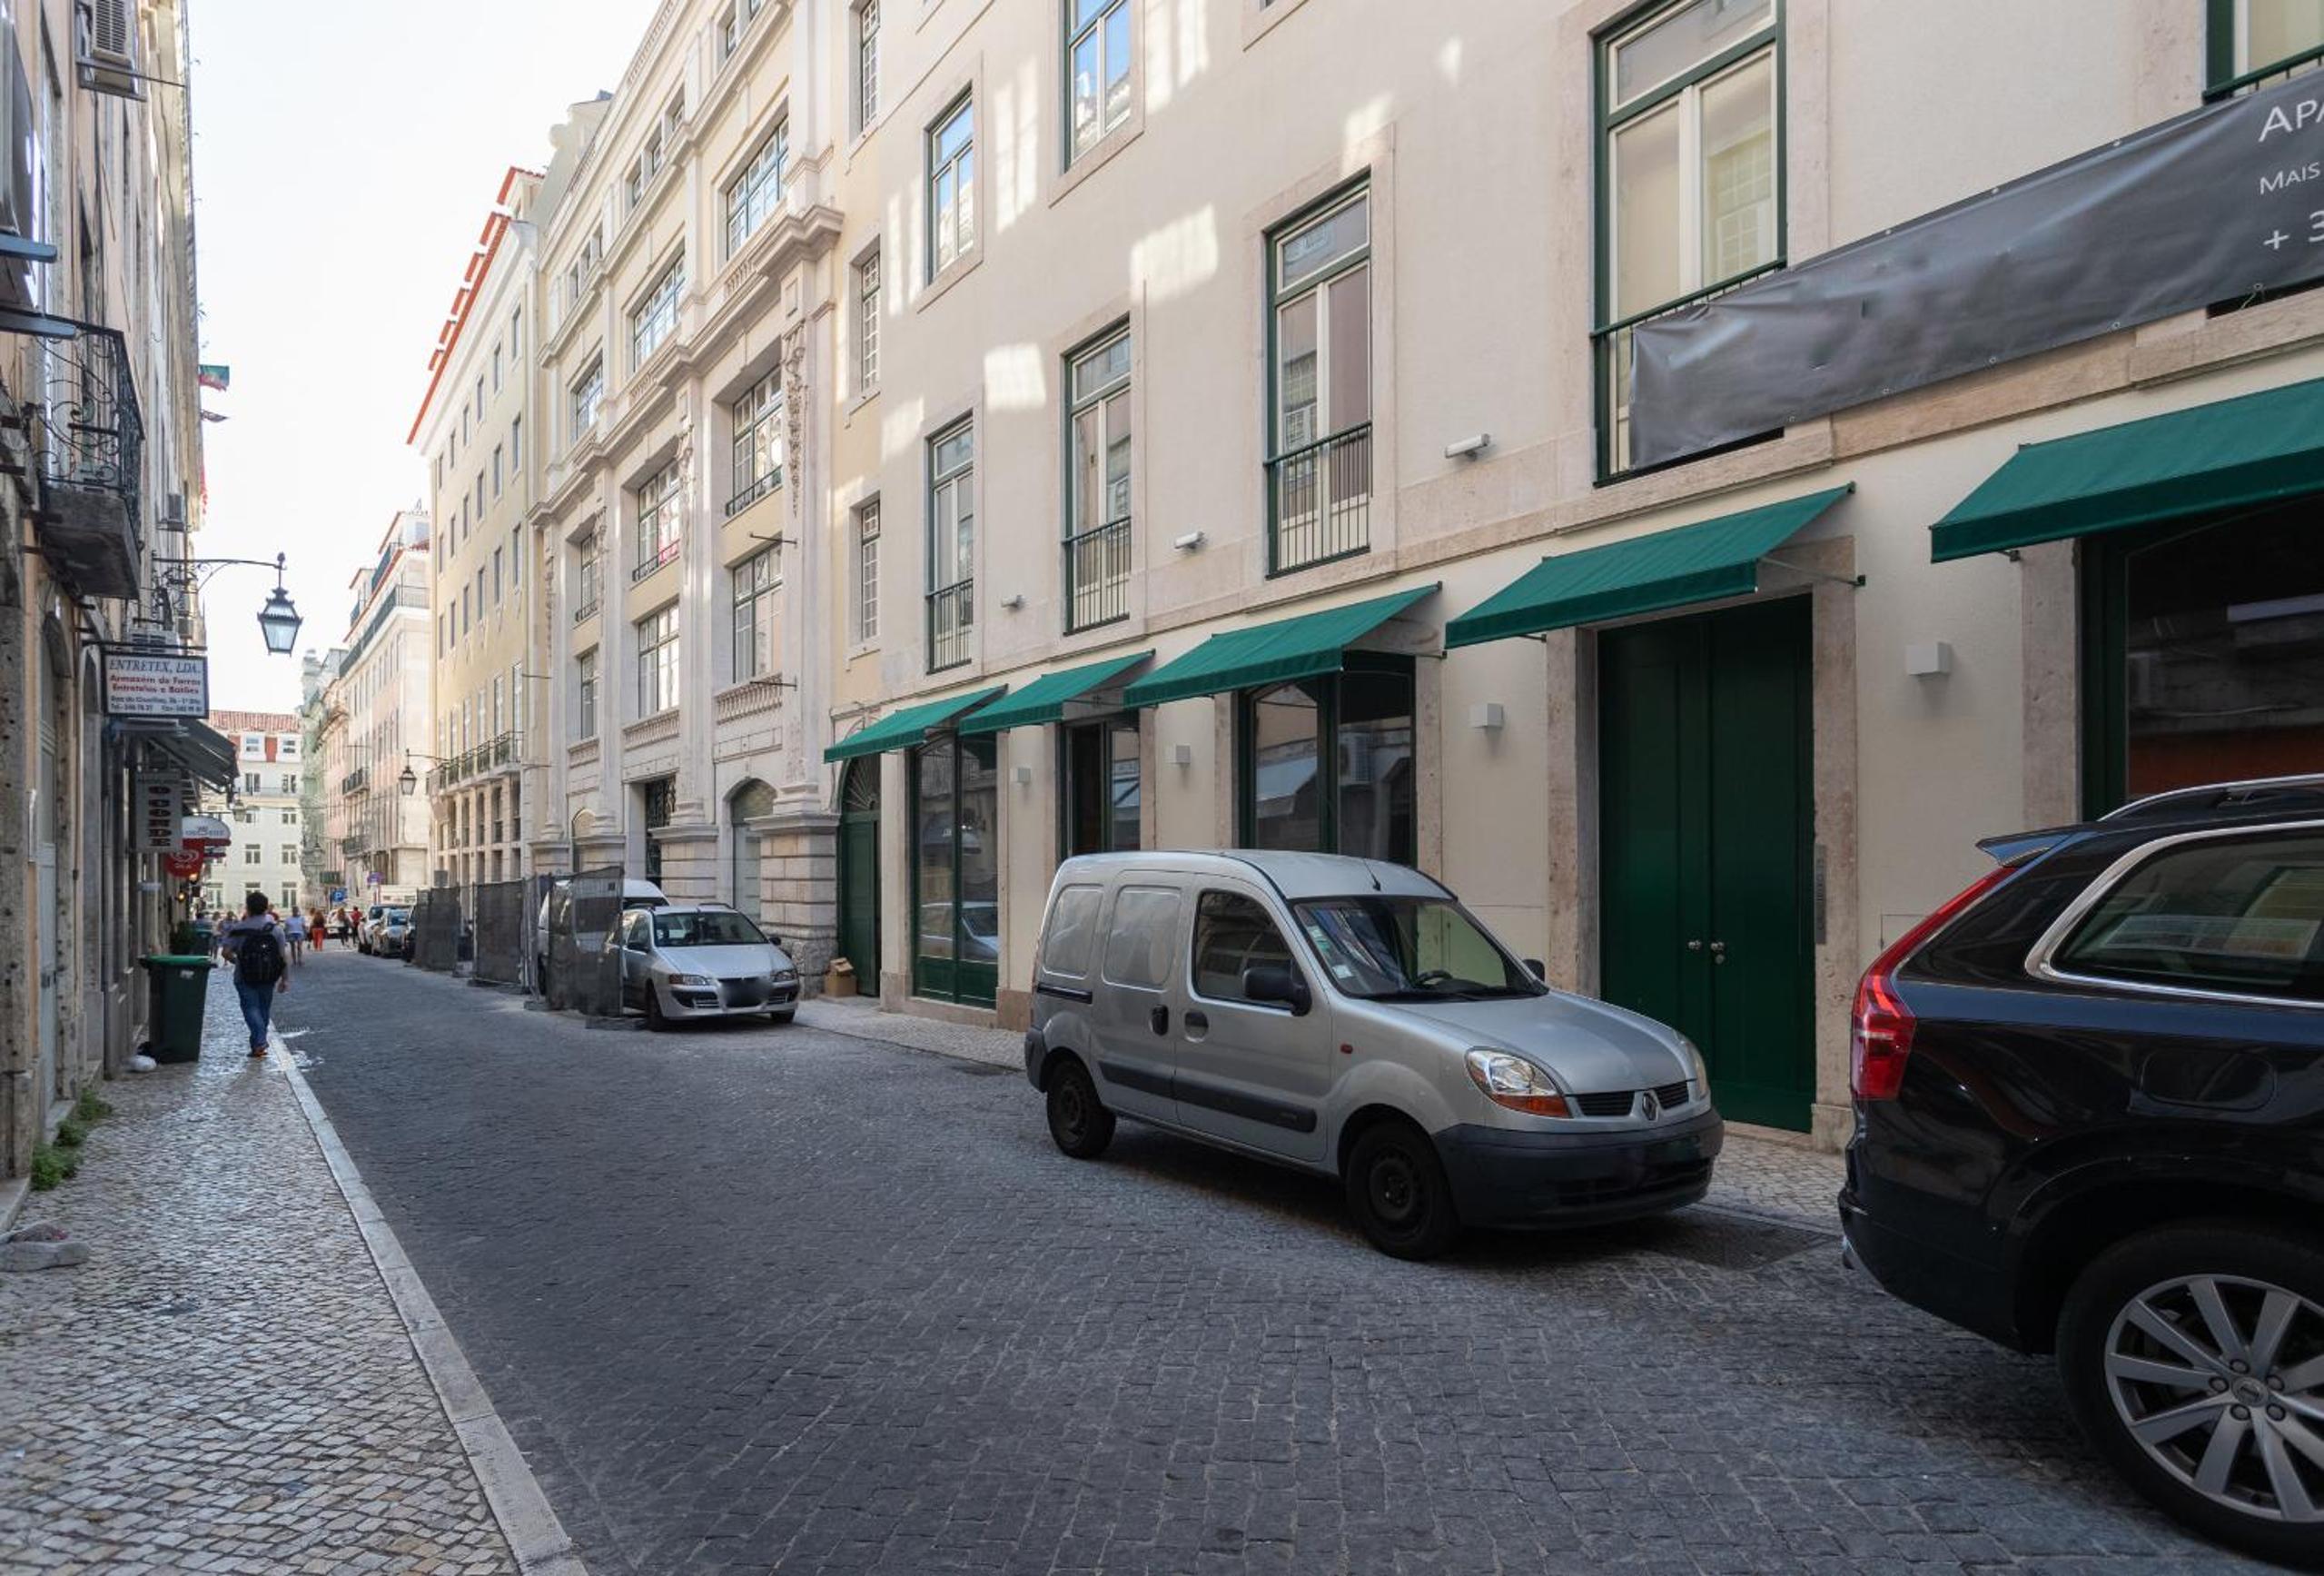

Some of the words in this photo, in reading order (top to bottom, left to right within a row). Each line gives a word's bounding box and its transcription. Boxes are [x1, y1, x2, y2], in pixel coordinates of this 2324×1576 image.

[2258, 100, 2324, 143] AP
[2260, 162, 2320, 194] MAIS
[2263, 230, 2289, 250] +
